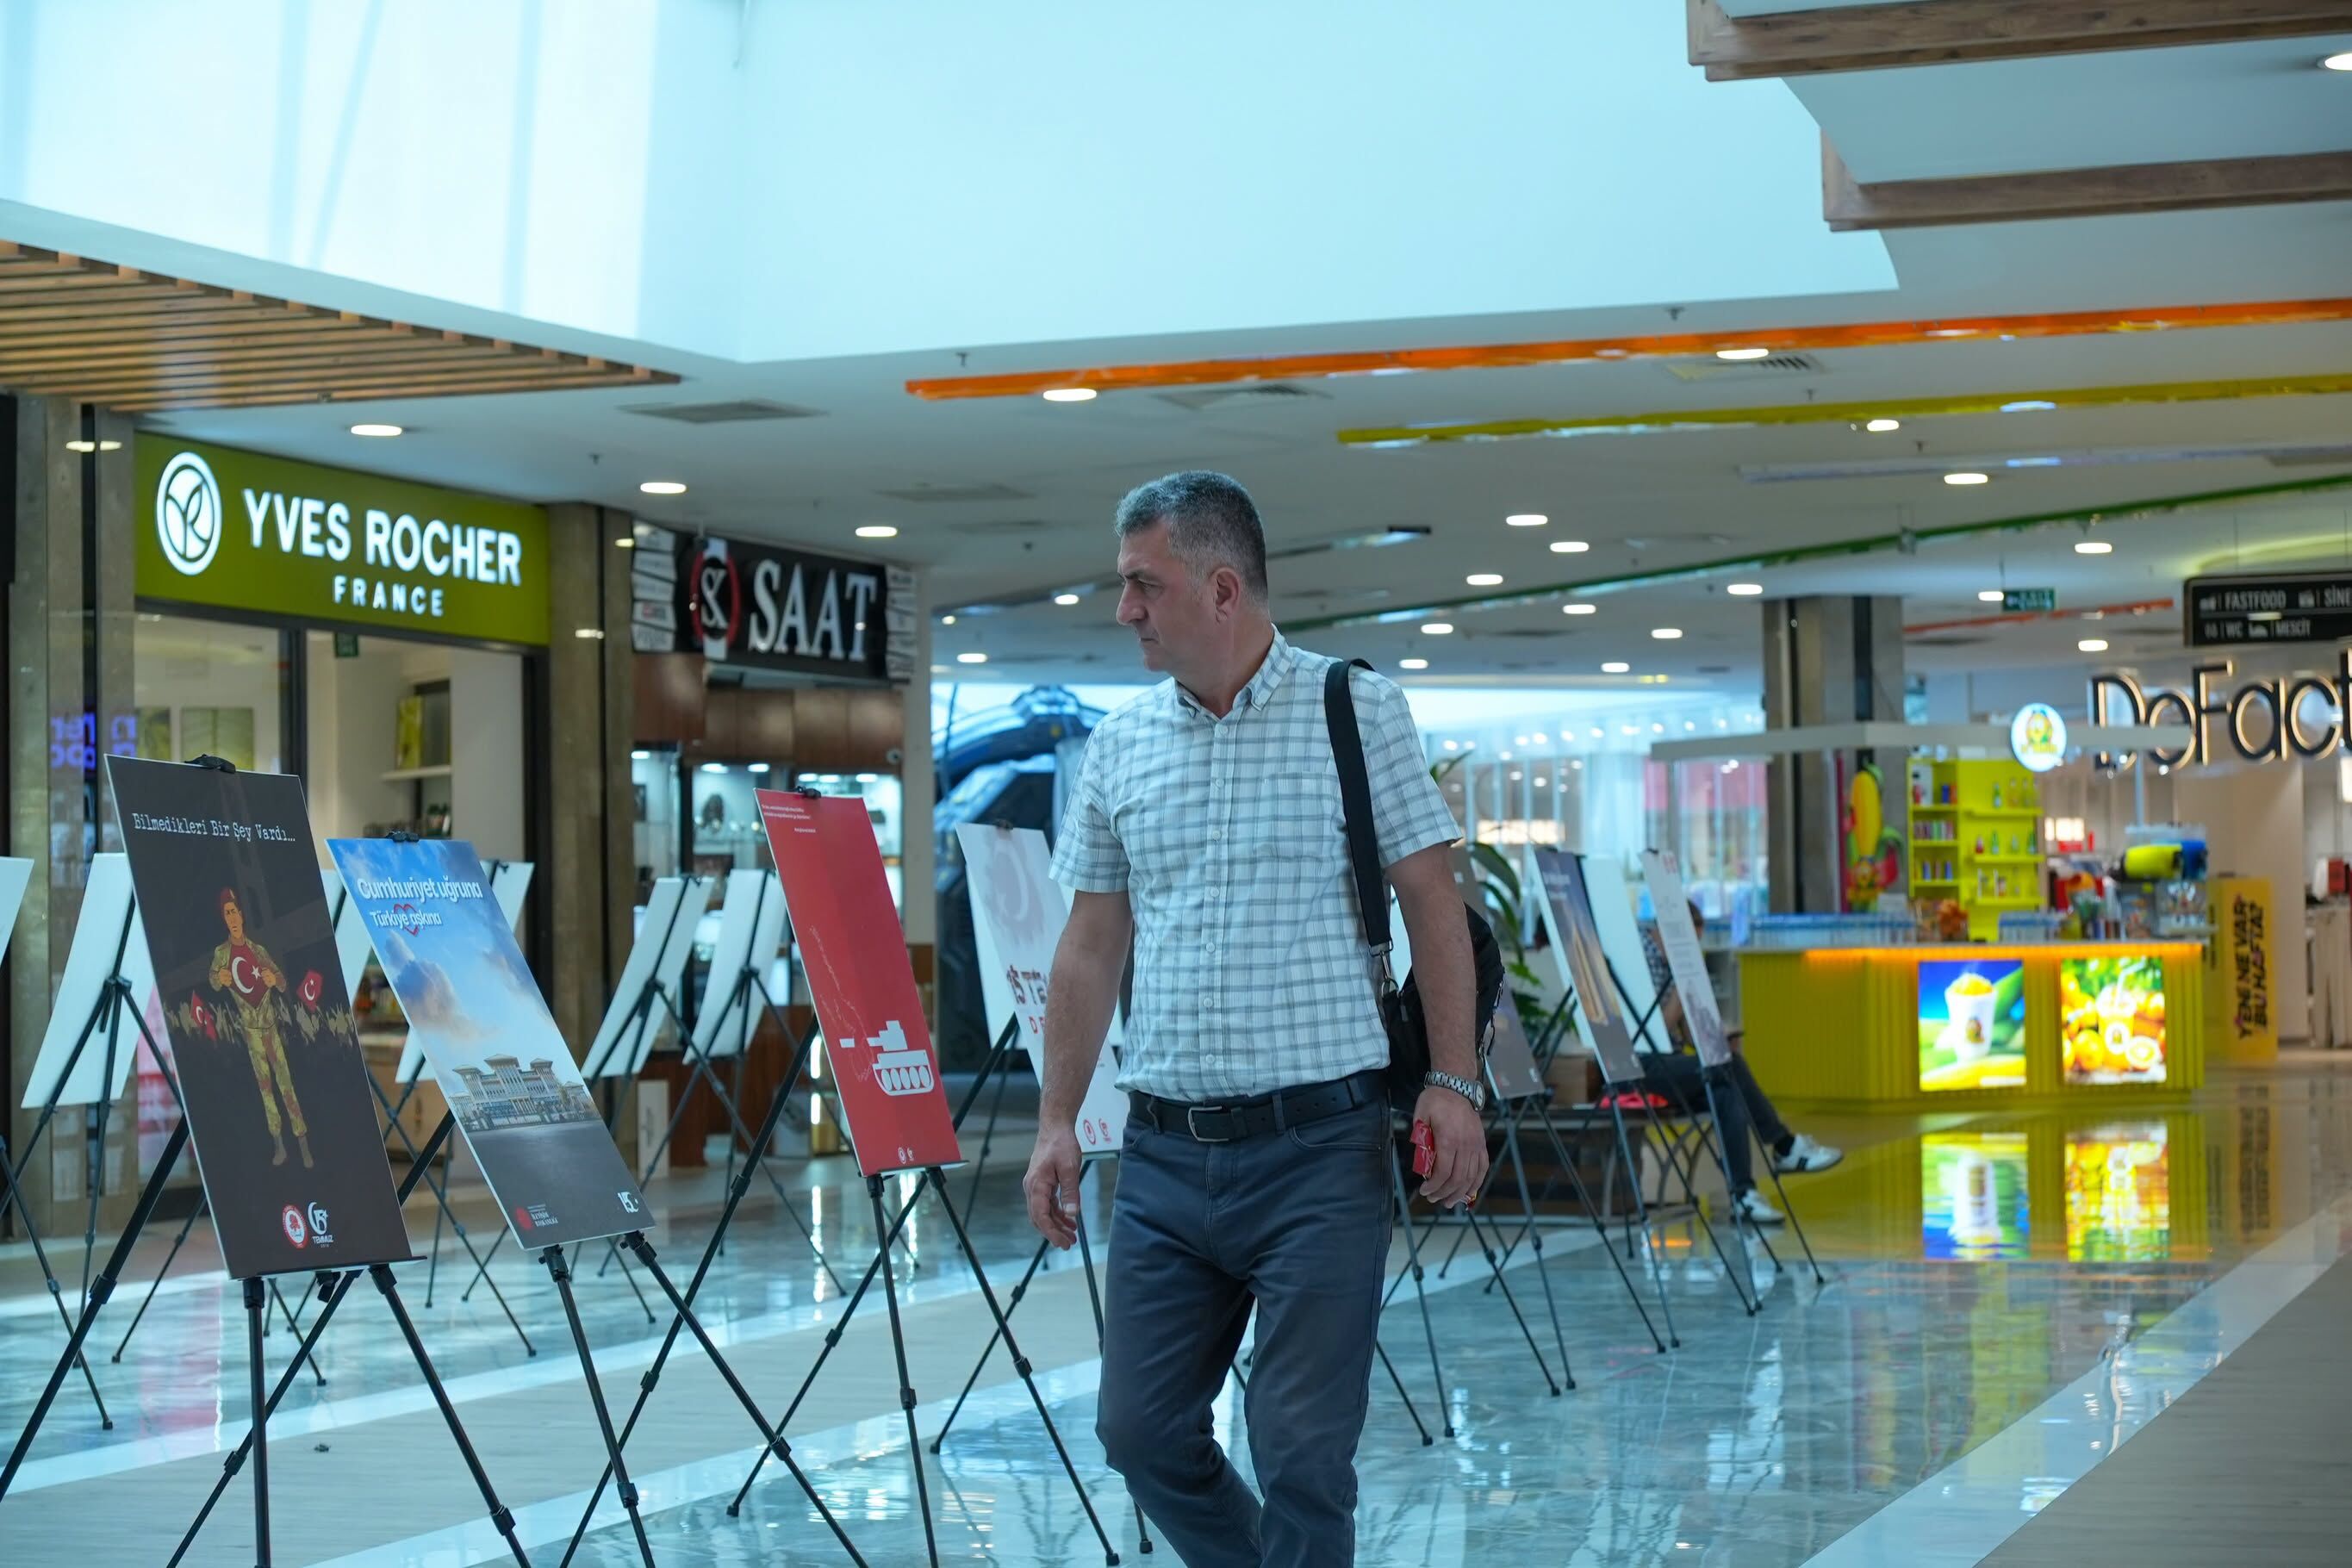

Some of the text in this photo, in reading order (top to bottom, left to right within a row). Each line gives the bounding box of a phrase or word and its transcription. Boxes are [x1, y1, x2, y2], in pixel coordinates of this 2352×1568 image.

[242, 488, 522, 587] YVES ROCHER
[333, 575, 444, 617] FRANCE
[748, 558, 878, 663] SAAT
[2224, 589, 2287, 611] FASTFOOD
[132, 812, 208, 835] Bilmedikleri
[210, 820, 230, 837] Bir
[233, 822, 252, 842] Şey
[357, 874, 483, 904] Cumhuriyet uğruna
[370, 908, 443, 930] Türkiye aşkına
